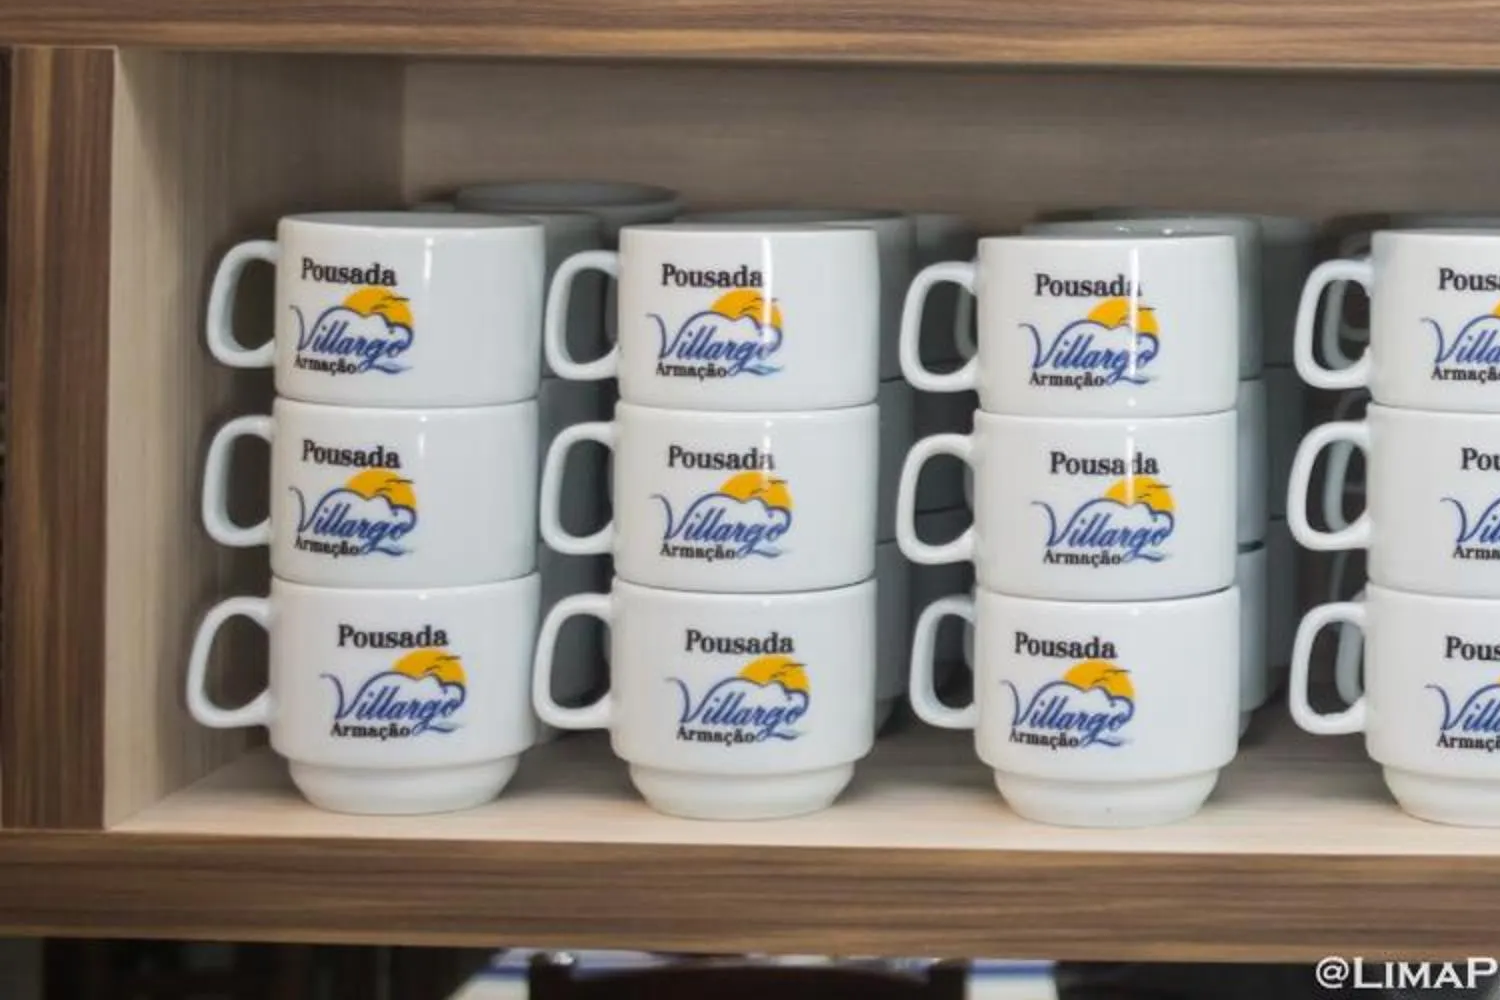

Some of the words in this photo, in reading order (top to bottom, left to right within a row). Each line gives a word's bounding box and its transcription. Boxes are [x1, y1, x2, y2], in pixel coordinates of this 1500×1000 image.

[300, 256, 398, 287] Pousada
[661, 262, 763, 289] Pousada
[293, 355, 357, 374] Armação
[656, 361, 727, 379] Armação
[1030, 371, 1106, 389] Armação
[301, 438, 402, 470] Pousada
[667, 444, 775, 471] Pousada
[294, 537, 360, 557] Armação
[661, 543, 735, 560] Armação
[1044, 549, 1121, 567] Armação
[337, 623, 450, 649] Pousada
[684, 628, 795, 656] Pousada
[1014, 630, 1118, 660] Pousada
[331, 721, 410, 739] Armação
[677, 726, 756, 745] Armação
[1010, 729, 1079, 748] Armação
